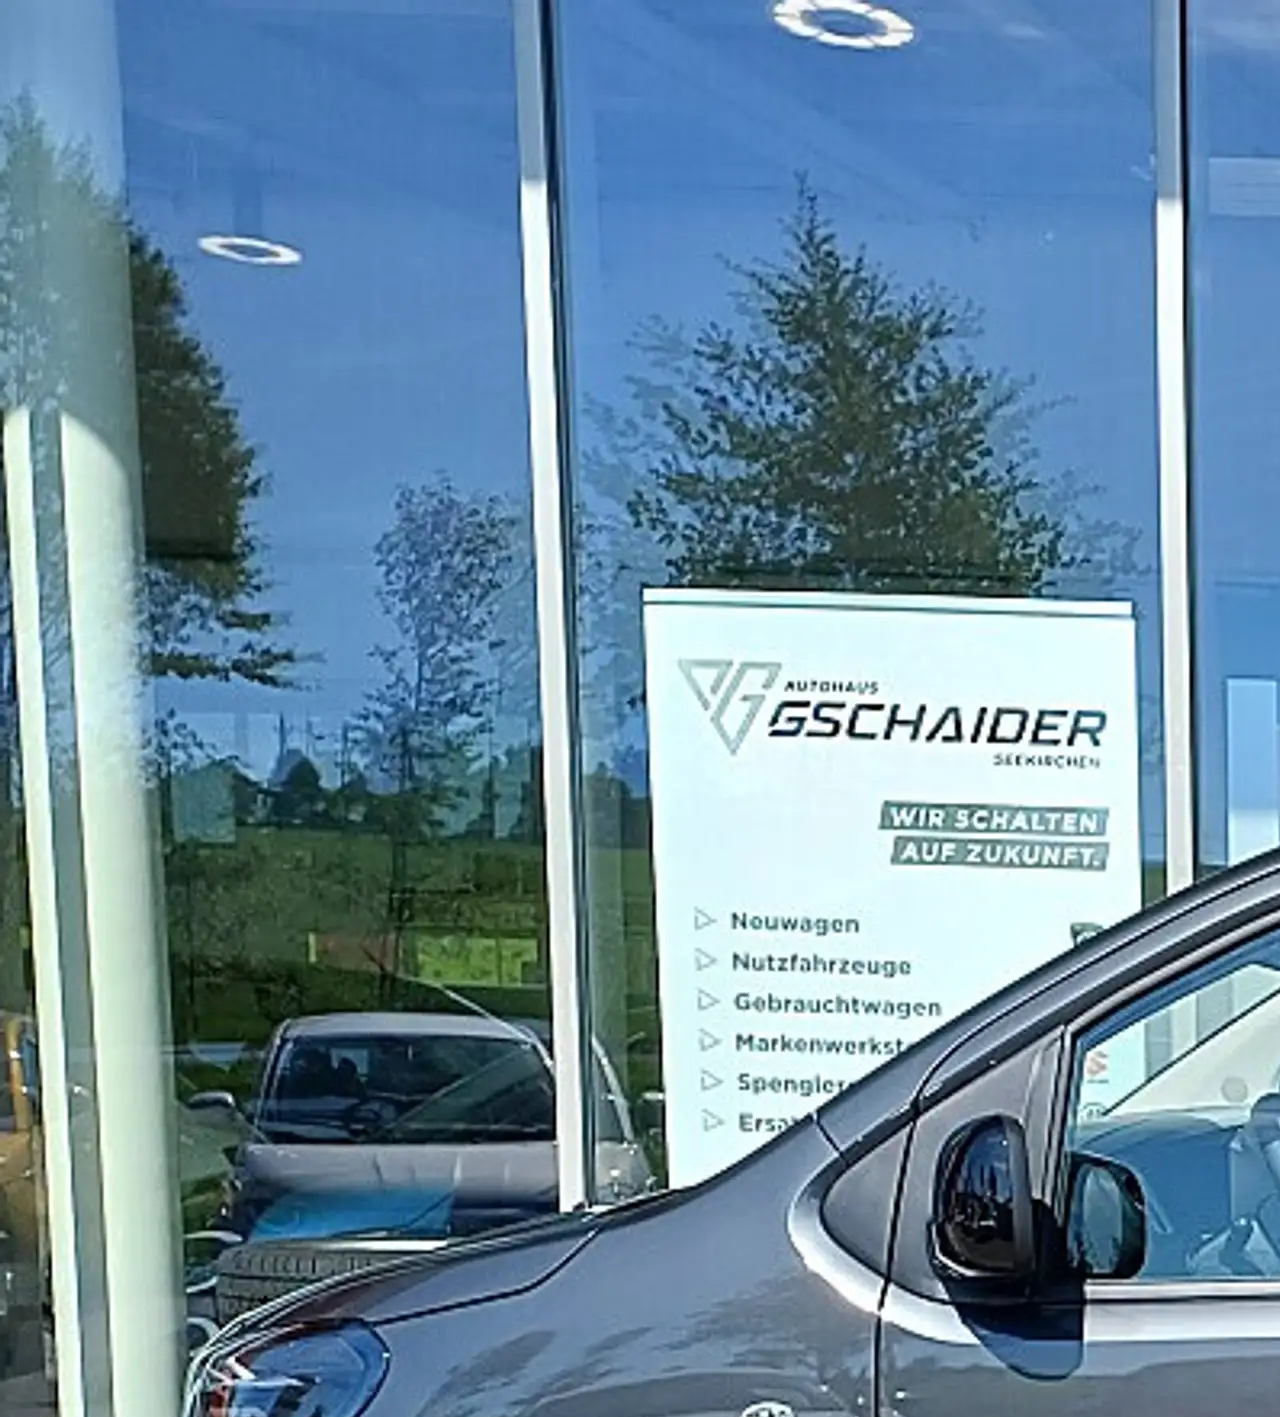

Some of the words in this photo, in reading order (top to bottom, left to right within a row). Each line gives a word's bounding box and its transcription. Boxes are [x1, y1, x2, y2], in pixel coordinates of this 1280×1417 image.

[784, 680, 880, 695] AUTOHAUS
[768, 700, 1107, 747] GSCHAIDER
[890, 806, 946, 828] WIR
[954, 809, 1098, 834] SCHALTEN
[899, 841, 957, 863] AUF
[966, 845, 1100, 868] ZUKUNFT.
[730, 912, 861, 936] Neuwagen
[732, 952, 912, 978] Nutzfahrzeuge
[734, 992, 943, 1020] Gebrauchtwagen
